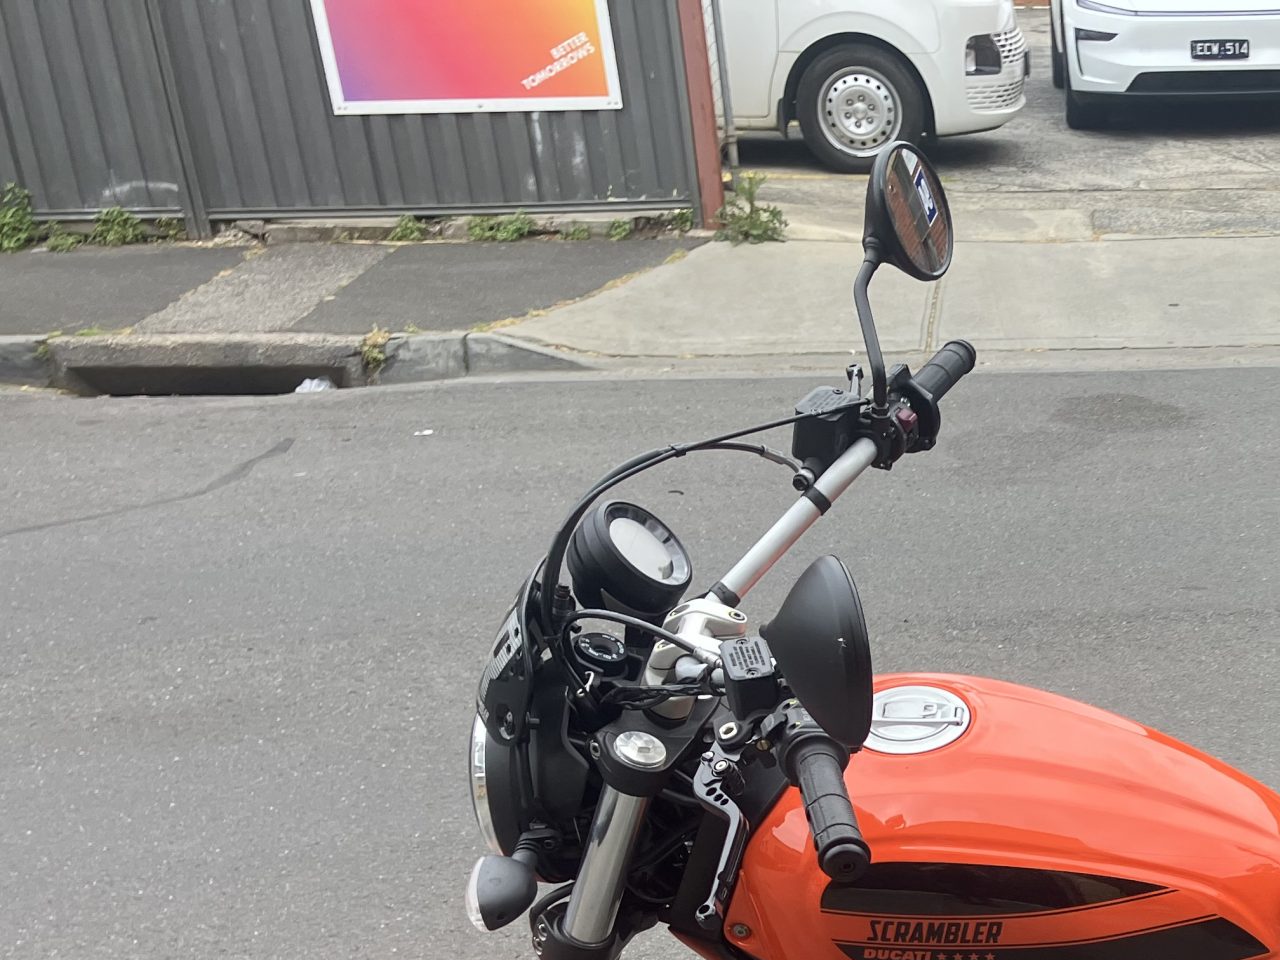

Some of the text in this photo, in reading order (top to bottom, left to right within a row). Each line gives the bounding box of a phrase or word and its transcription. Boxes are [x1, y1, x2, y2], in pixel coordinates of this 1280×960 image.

[550, 32, 588, 60] BETTER
[520, 42, 595, 90] TOMORROWS
[867, 921, 1003, 944] SCRAMBLER
[863, 948, 932, 960] DUCATI
